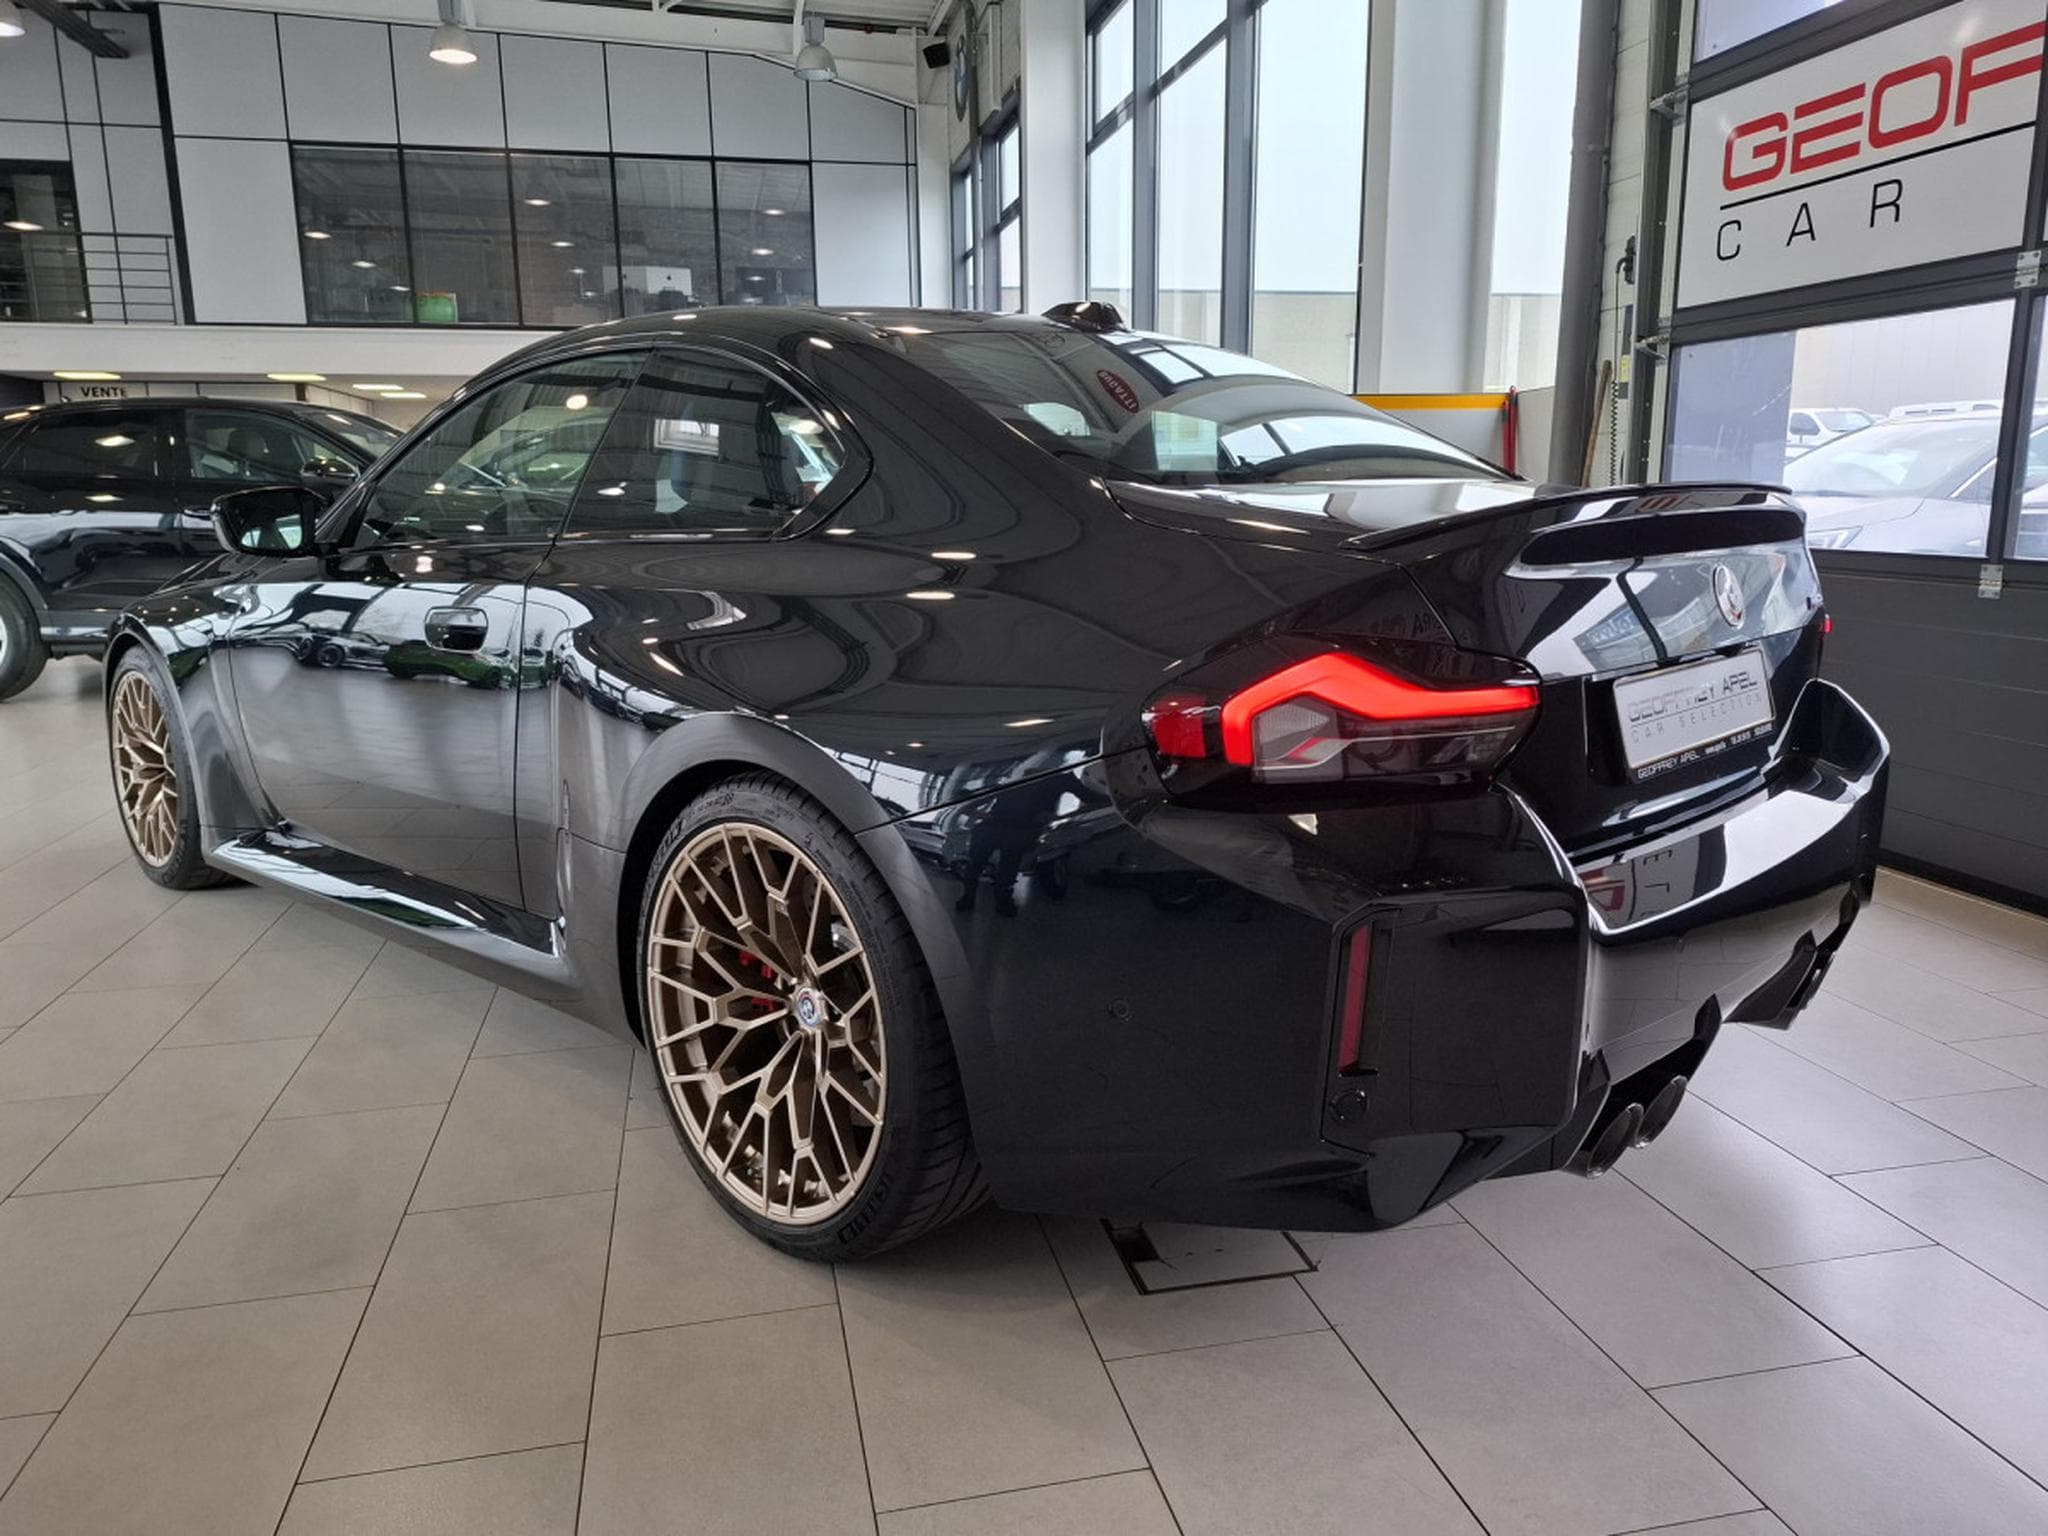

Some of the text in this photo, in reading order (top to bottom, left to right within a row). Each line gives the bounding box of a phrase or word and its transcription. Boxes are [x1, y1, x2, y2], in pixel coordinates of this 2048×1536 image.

[1716, 179, 1902, 261] CAR
[80, 386, 128, 398] VENTE
[1722, 671, 1758, 693] APEL
[1631, 724, 1664, 744] CAR
